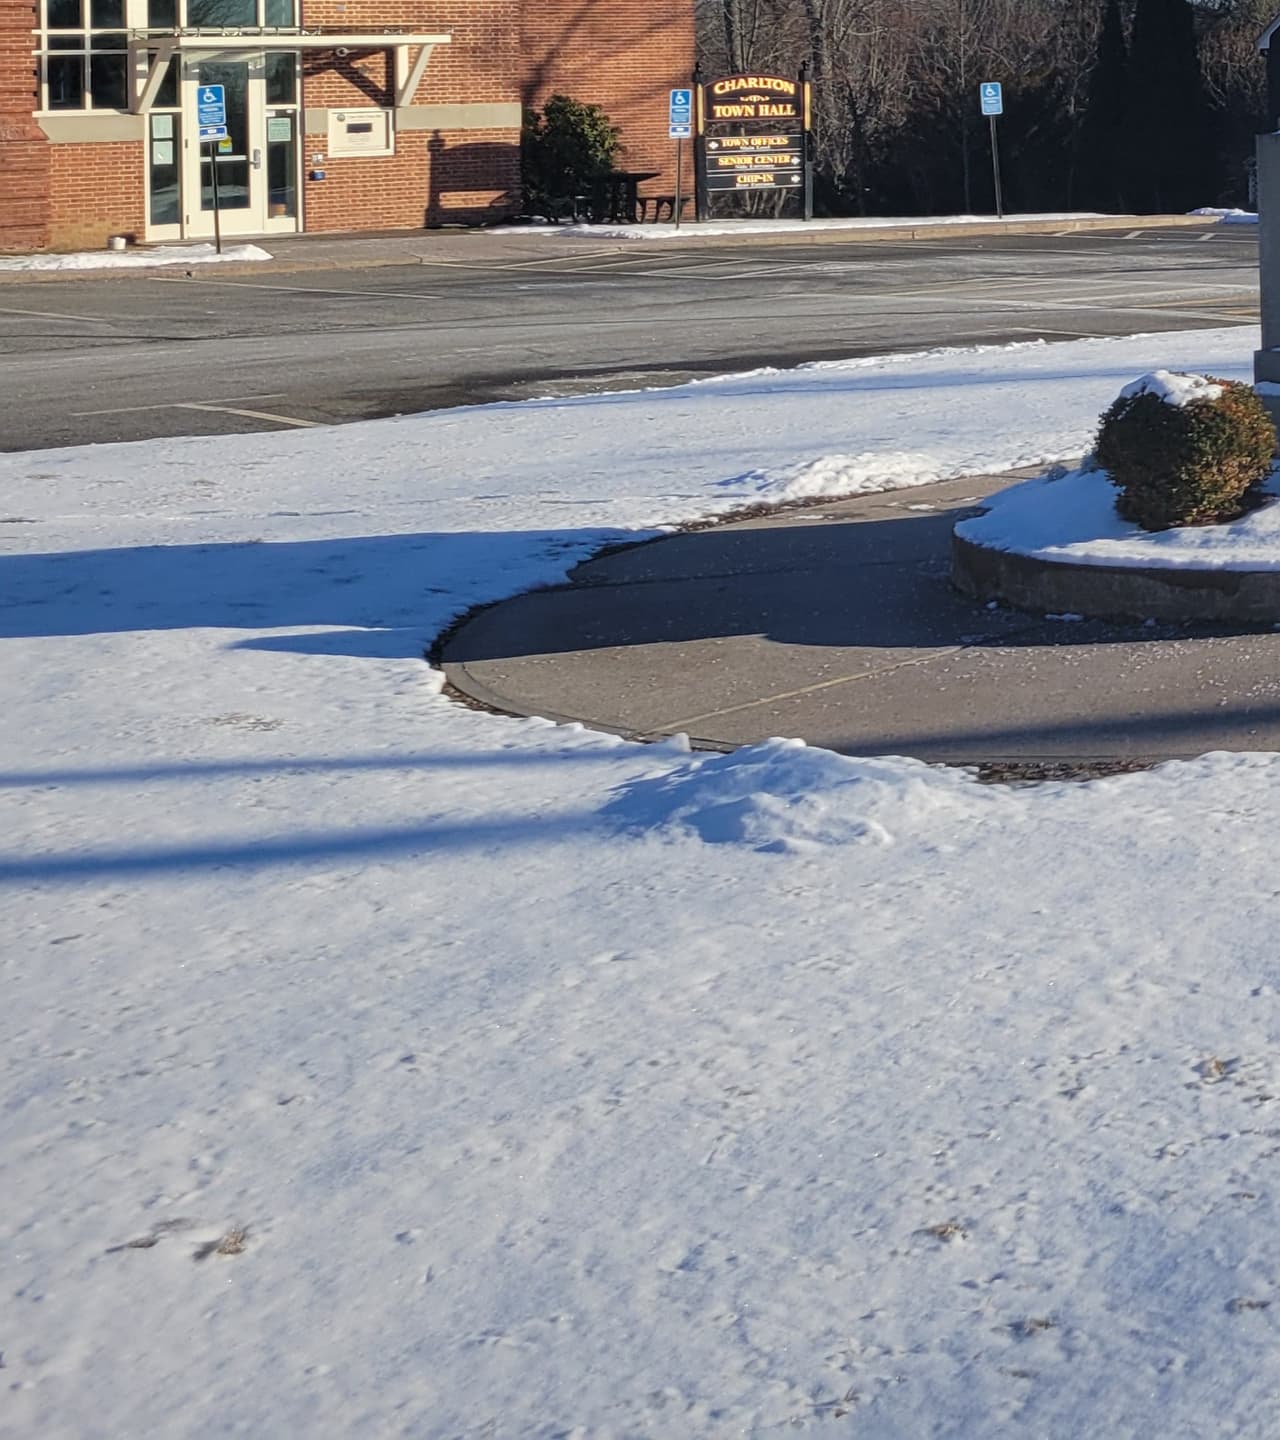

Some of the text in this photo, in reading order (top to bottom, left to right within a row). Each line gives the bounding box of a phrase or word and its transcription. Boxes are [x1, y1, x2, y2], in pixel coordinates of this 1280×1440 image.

[714, 77, 795, 94] CHARLTON
[713, 104, 796, 117] TOWN HALL
[722, 137, 789, 147] TOWN OFFICES
[718, 155, 791, 165] SENIOR CENTER
